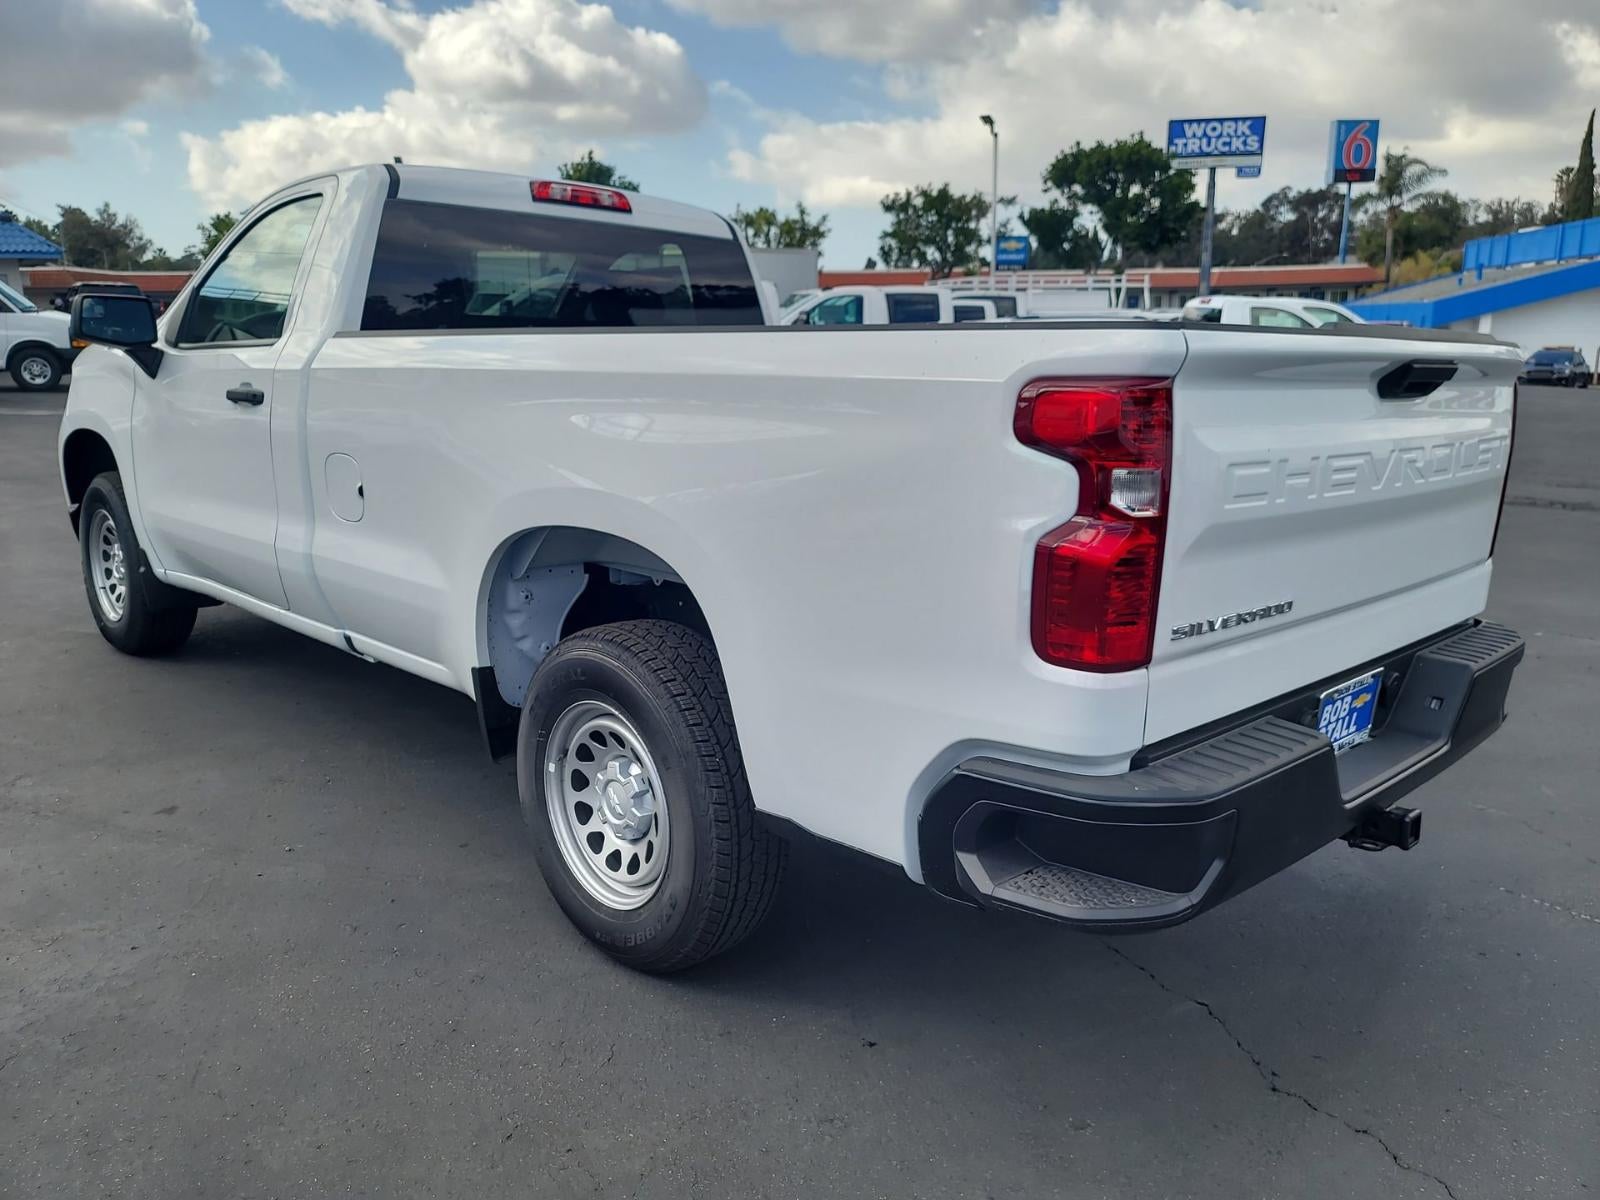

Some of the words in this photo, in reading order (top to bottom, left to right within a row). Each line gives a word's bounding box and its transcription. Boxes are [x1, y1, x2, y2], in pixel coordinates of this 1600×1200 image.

[1173, 134, 1260, 153] TRUCKS
[1183, 120, 1252, 139] WORK
[1342, 122, 1372, 170] 6
[1223, 435, 1507, 509] CHEVROLET
[1170, 600, 1294, 641] SILVERADO
[1319, 696, 1352, 728] BOB
